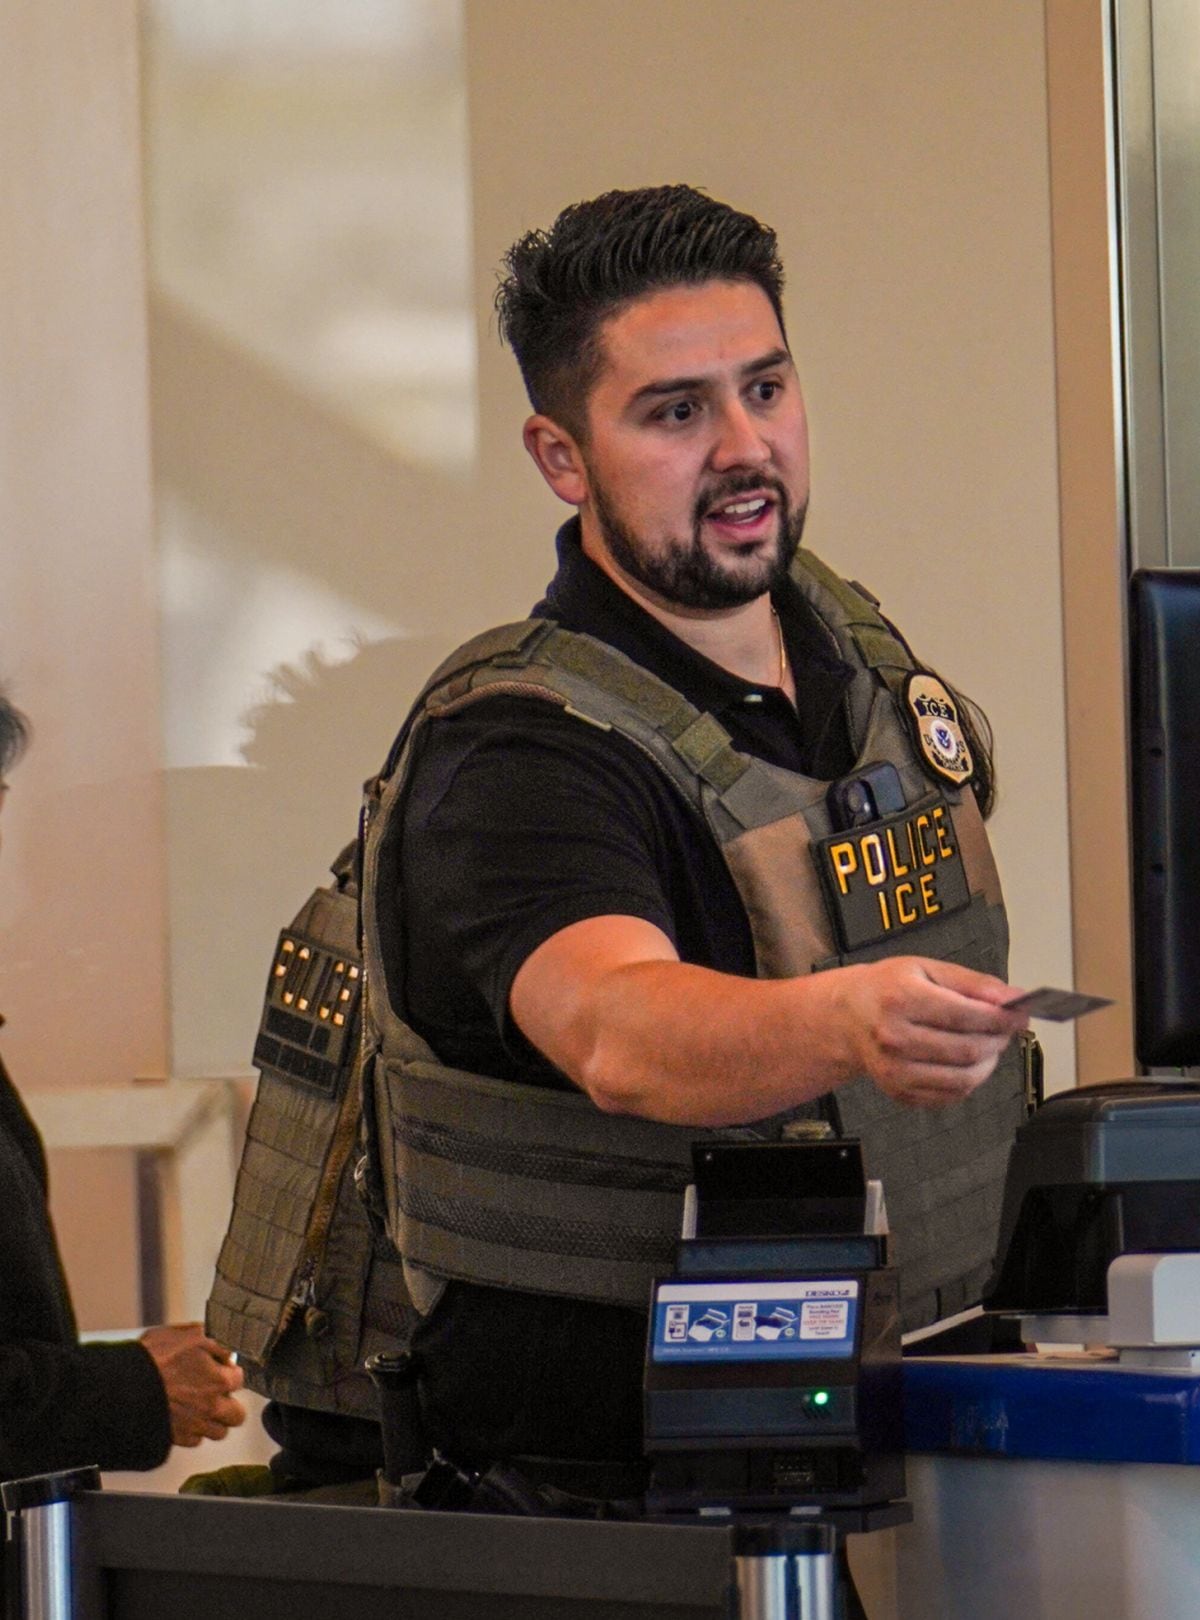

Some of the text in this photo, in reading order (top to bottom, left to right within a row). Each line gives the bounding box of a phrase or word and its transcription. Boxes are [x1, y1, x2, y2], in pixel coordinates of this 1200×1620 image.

[923, 701, 949, 718] ICE
[830, 807, 953, 894] POLICE
[878, 873, 940, 930] ICE
